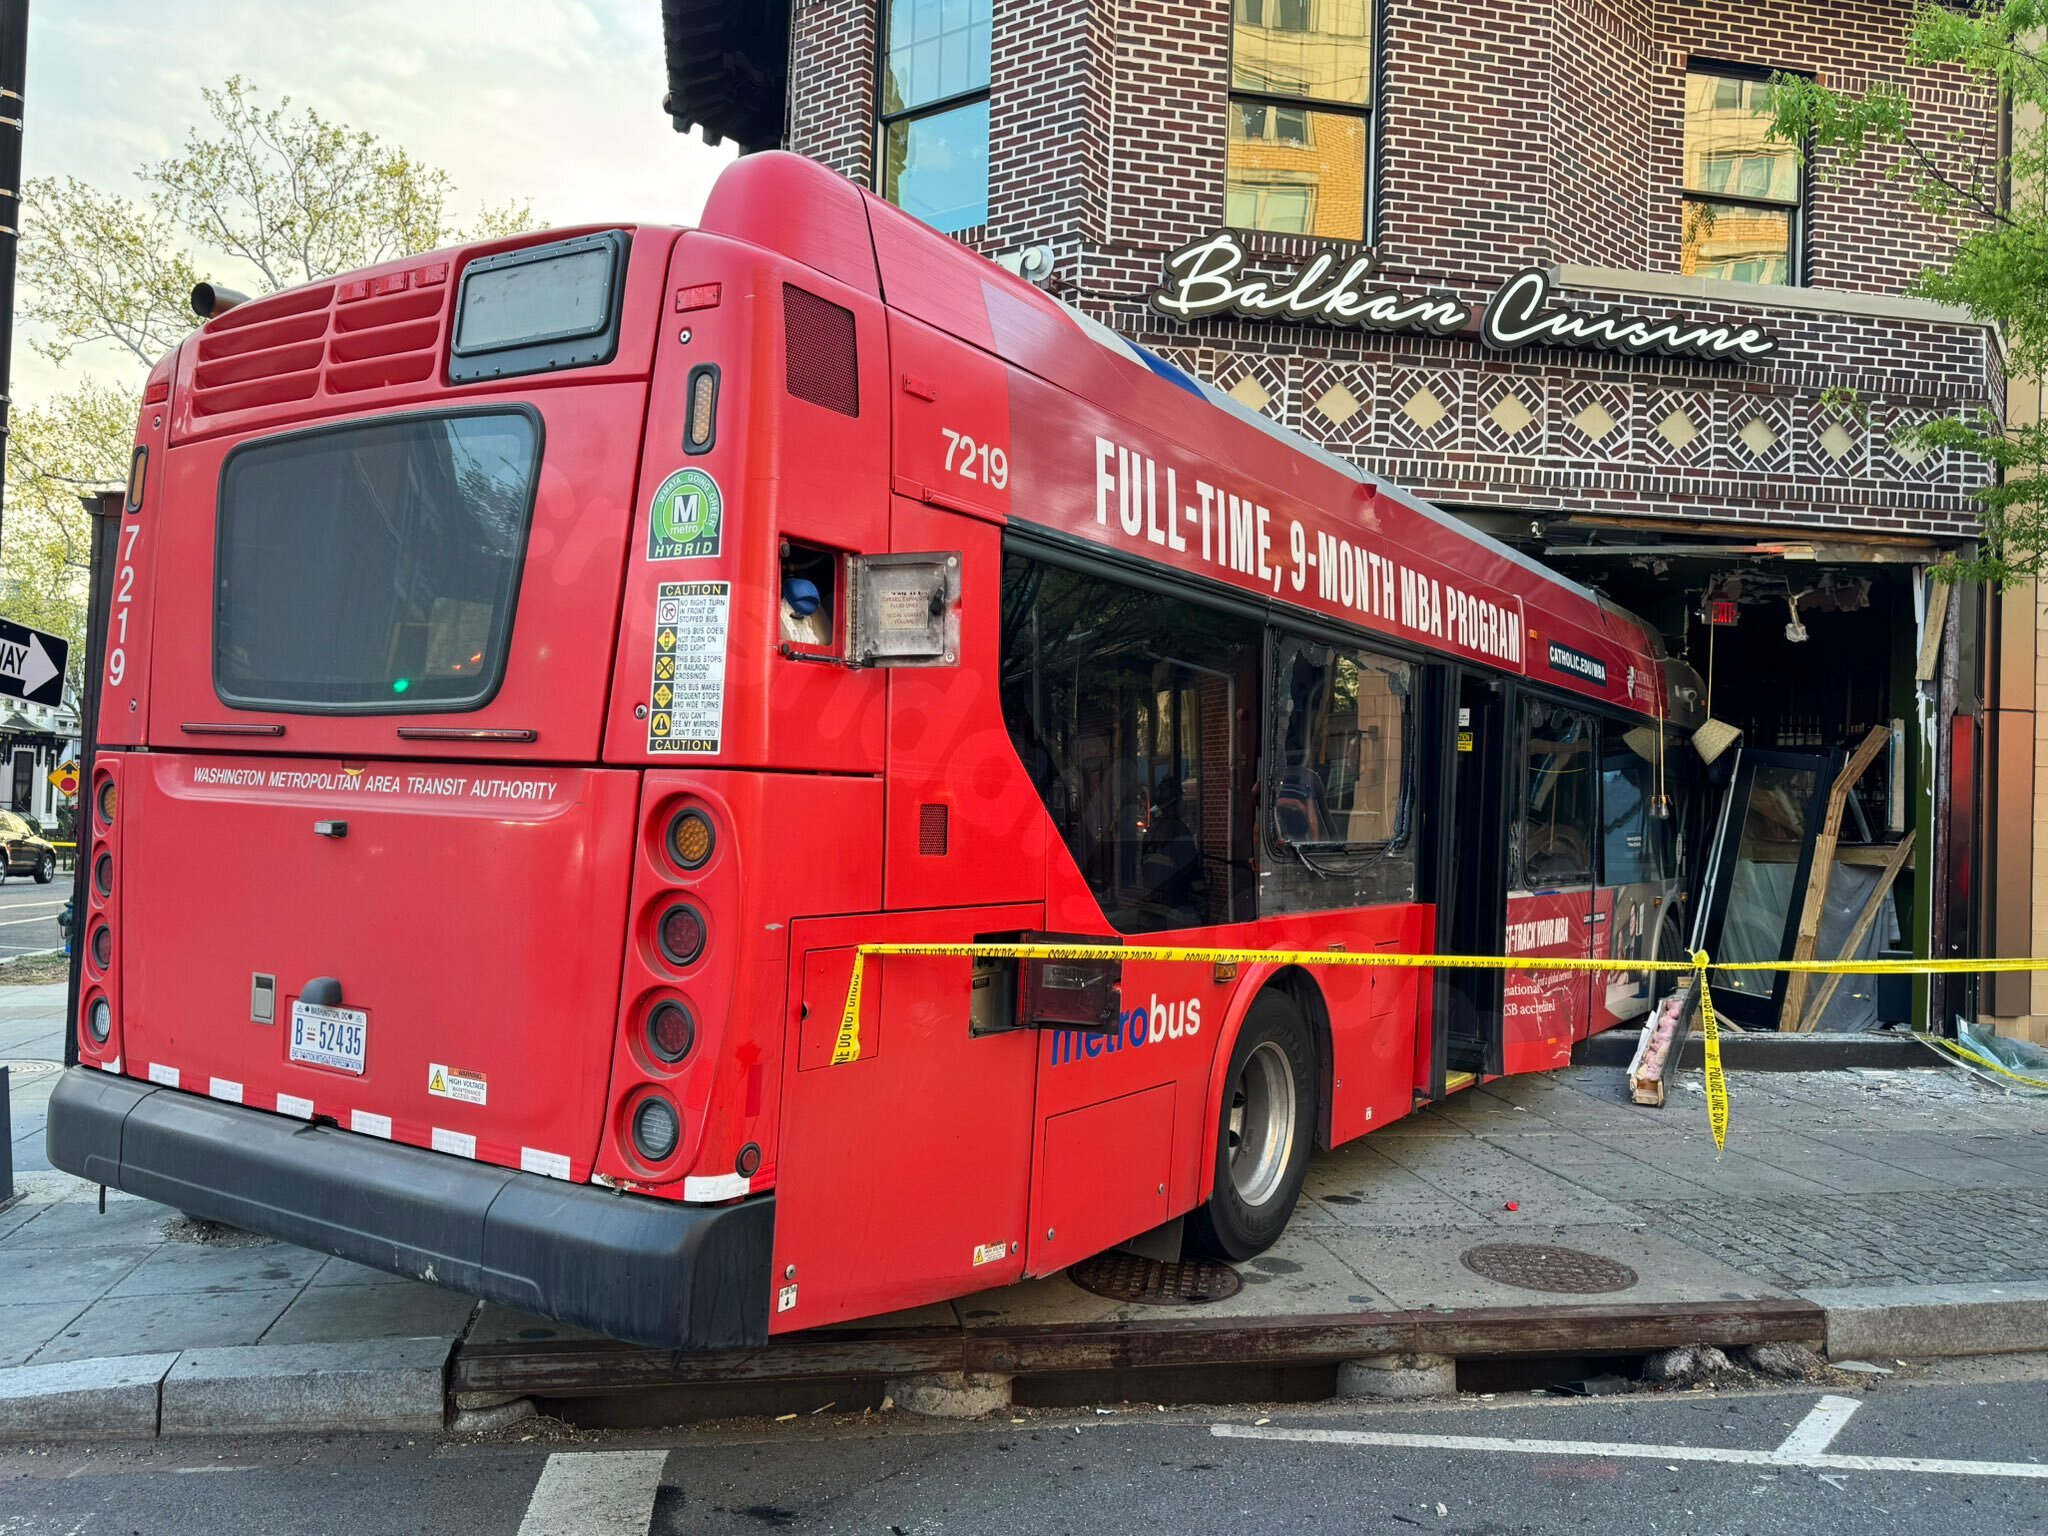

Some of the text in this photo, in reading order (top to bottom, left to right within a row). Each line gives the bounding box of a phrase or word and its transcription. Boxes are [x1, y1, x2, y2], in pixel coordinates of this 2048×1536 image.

[1158, 234, 1773, 354] Balkan Cuisine
[941, 427, 1009, 490] 7219
[658, 473, 719, 527] WMATA GOING GREEN
[673, 494, 698, 523] M
[670, 525, 699, 534] metro
[654, 542, 713, 557] HYBRID
[1095, 435, 1521, 664] FULL-TIME, 9-MONTH MBA PROGRAM
[665, 585, 721, 596] CAUTION
[109, 525, 140, 687] 7219
[1712, 602, 1735, 623] EXIT
[1549, 646, 1606, 681] CATHOLIC.EDU/MBA
[655, 740, 712, 751] CAUTION
[193, 767, 558, 800] WASHINGTON METROPOLITAN AREA TRANSIT AUTHORITY
[1537, 918, 1554, 947] YOUR
[1554, 917, 1569, 944] MBA
[1520, 998, 1556, 1015] accredited
[295, 1017, 362, 1056] B 52435
[838, 1035, 852, 1048] DO
[449, 1078, 486, 1091] HIGH VOLTAGE
[458, 1070, 482, 1080] WARNING
[1709, 1066, 1722, 1092] POLICE
[452, 1086, 481, 1097] MAINTENANCE
[452, 1092, 469, 1100] ACCESS
[1711, 1093, 1724, 1111] LINE
[1713, 1112, 1724, 1125] DO
